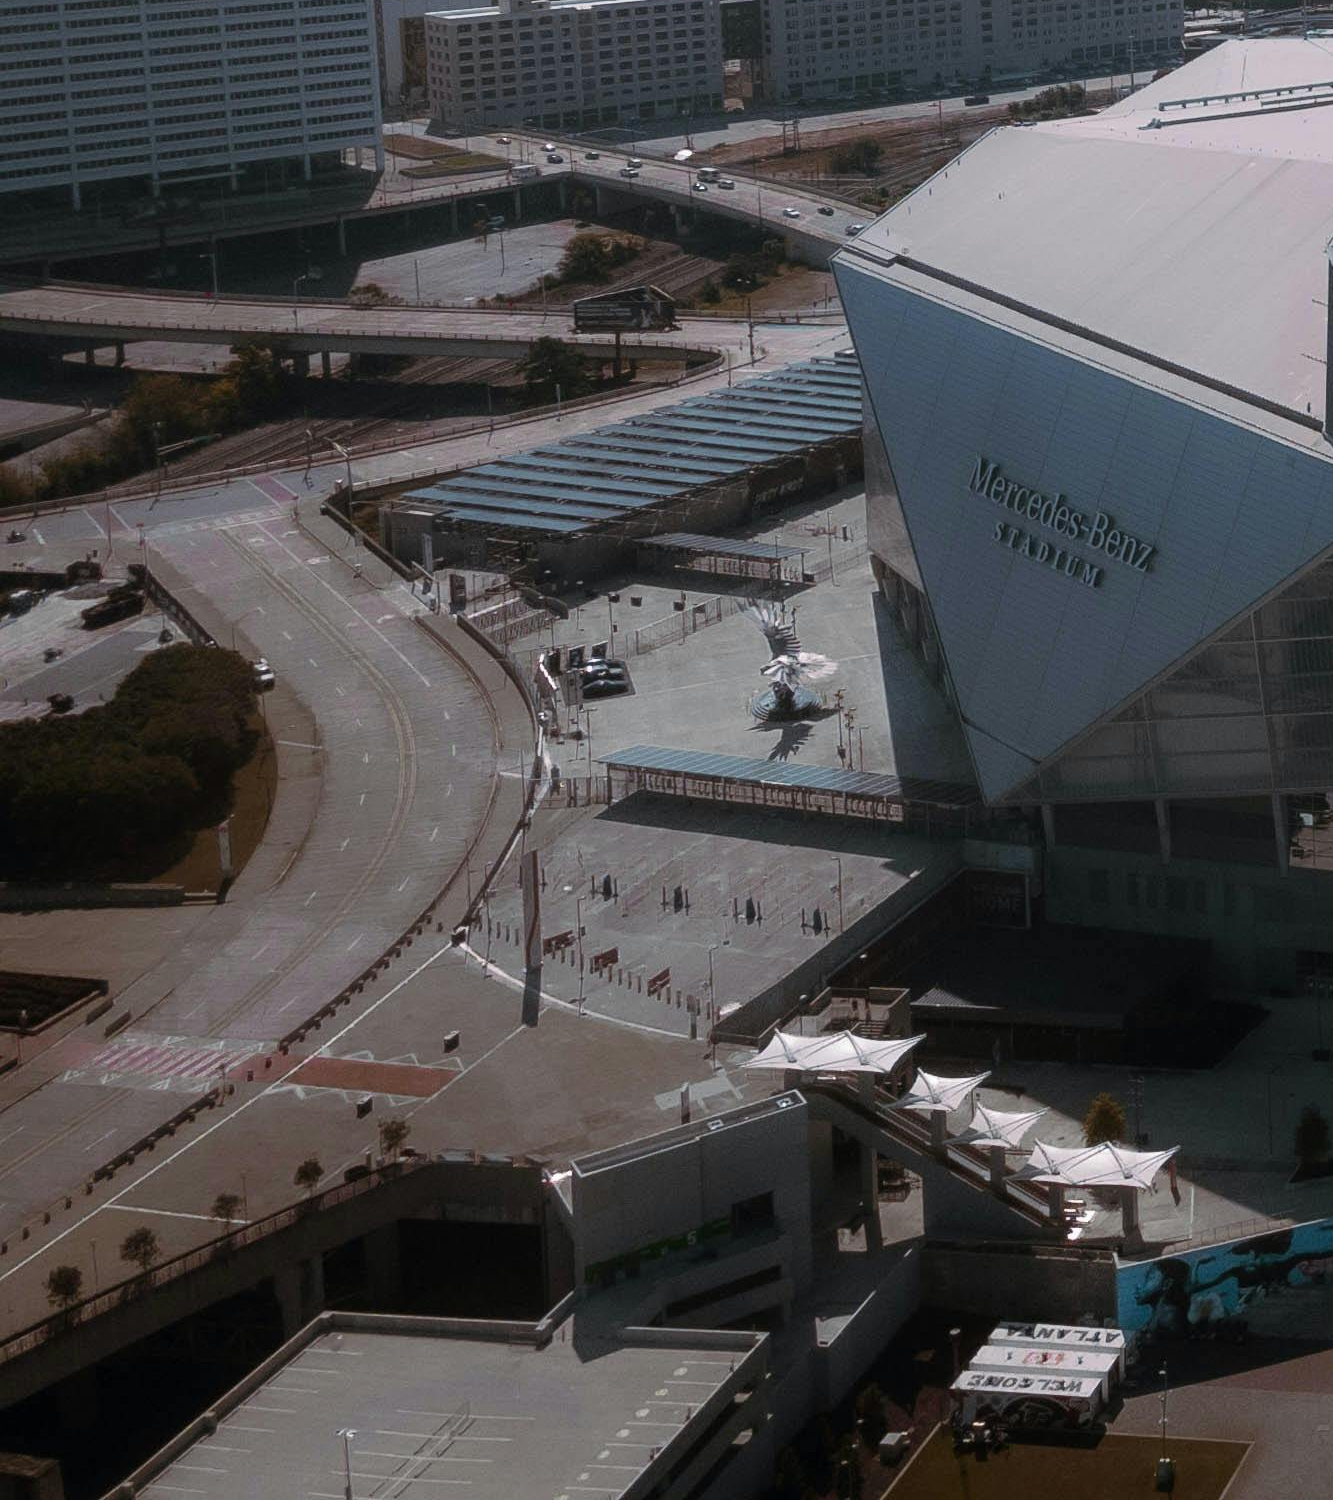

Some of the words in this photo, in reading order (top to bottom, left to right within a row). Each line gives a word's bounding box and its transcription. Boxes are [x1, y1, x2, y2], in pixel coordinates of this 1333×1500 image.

[967, 453, 1153, 572] Mercedes-Benz
[992, 521, 1100, 587] STADIUM
[1006, 1324, 1119, 1343] ATLANTA
[967, 1374, 1082, 1392] WELCOME
